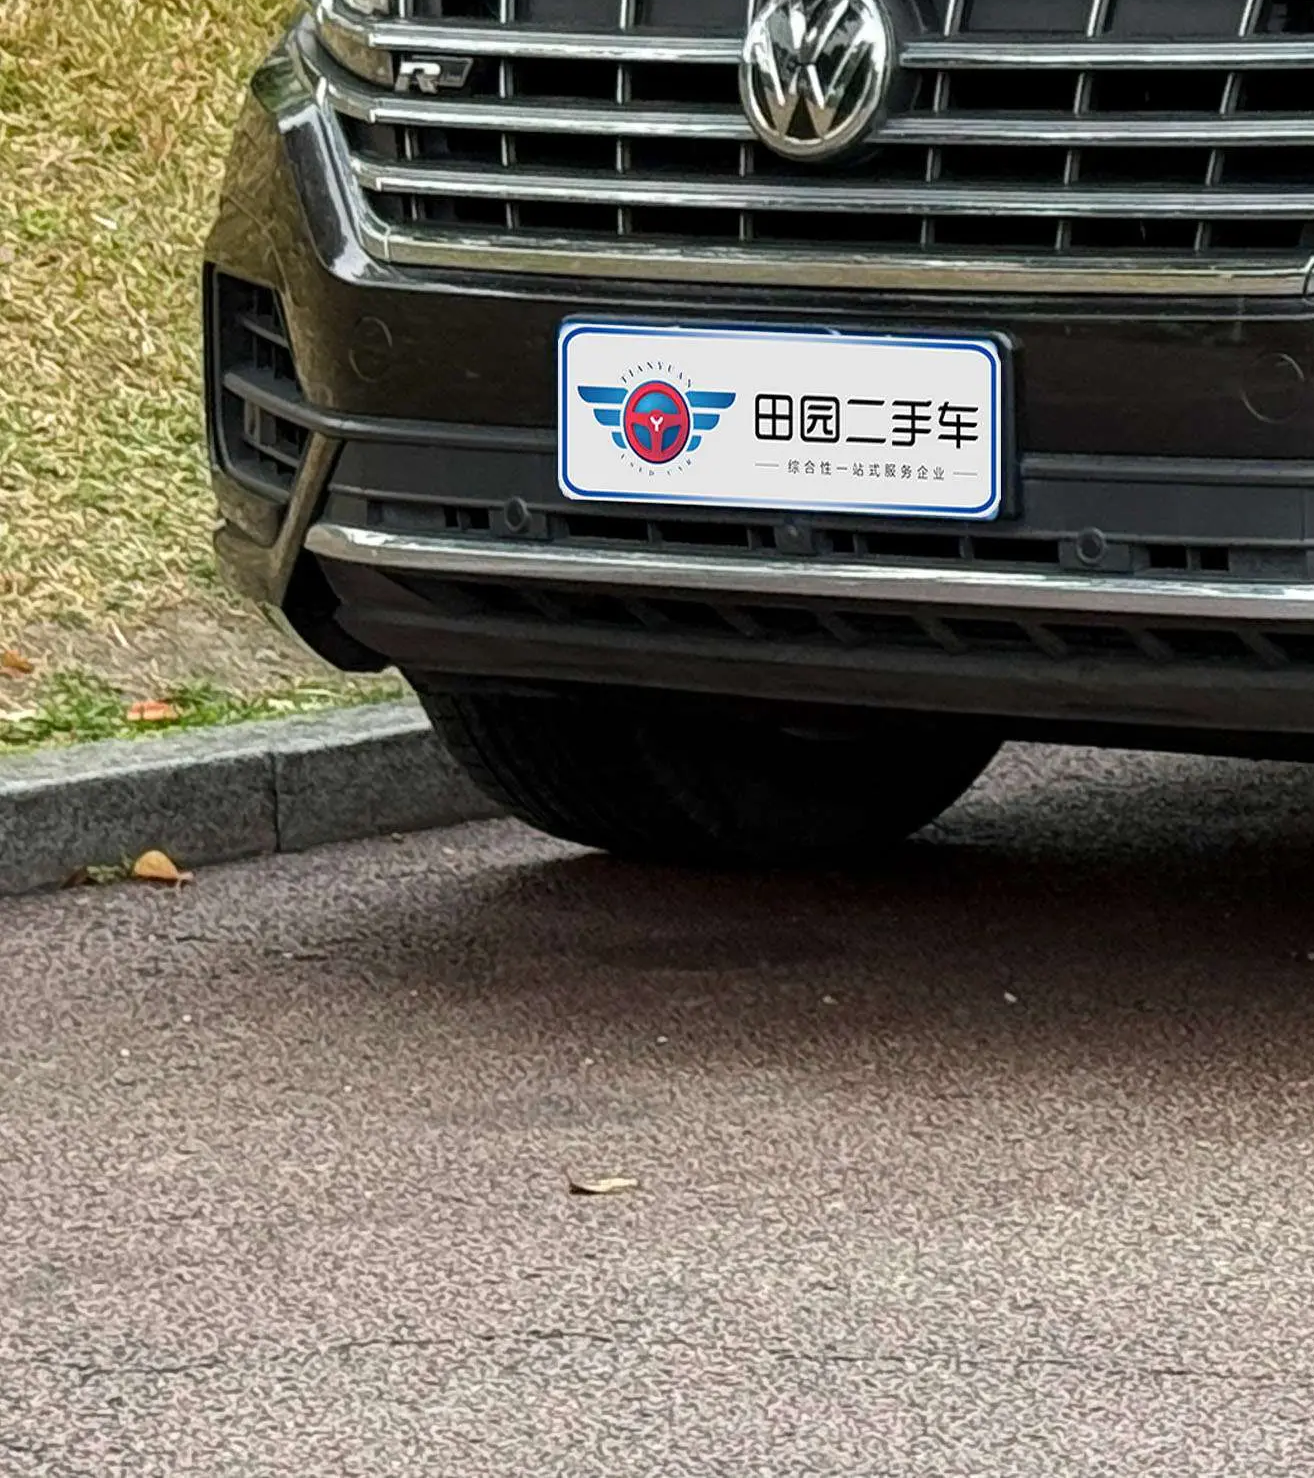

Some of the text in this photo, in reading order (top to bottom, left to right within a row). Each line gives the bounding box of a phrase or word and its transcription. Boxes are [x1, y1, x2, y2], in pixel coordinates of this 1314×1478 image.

[649, 415, 664, 432] Y
[754, 392, 979, 449] 田园二手车
[787, 458, 945, 481] 综合性一站式服务企业
